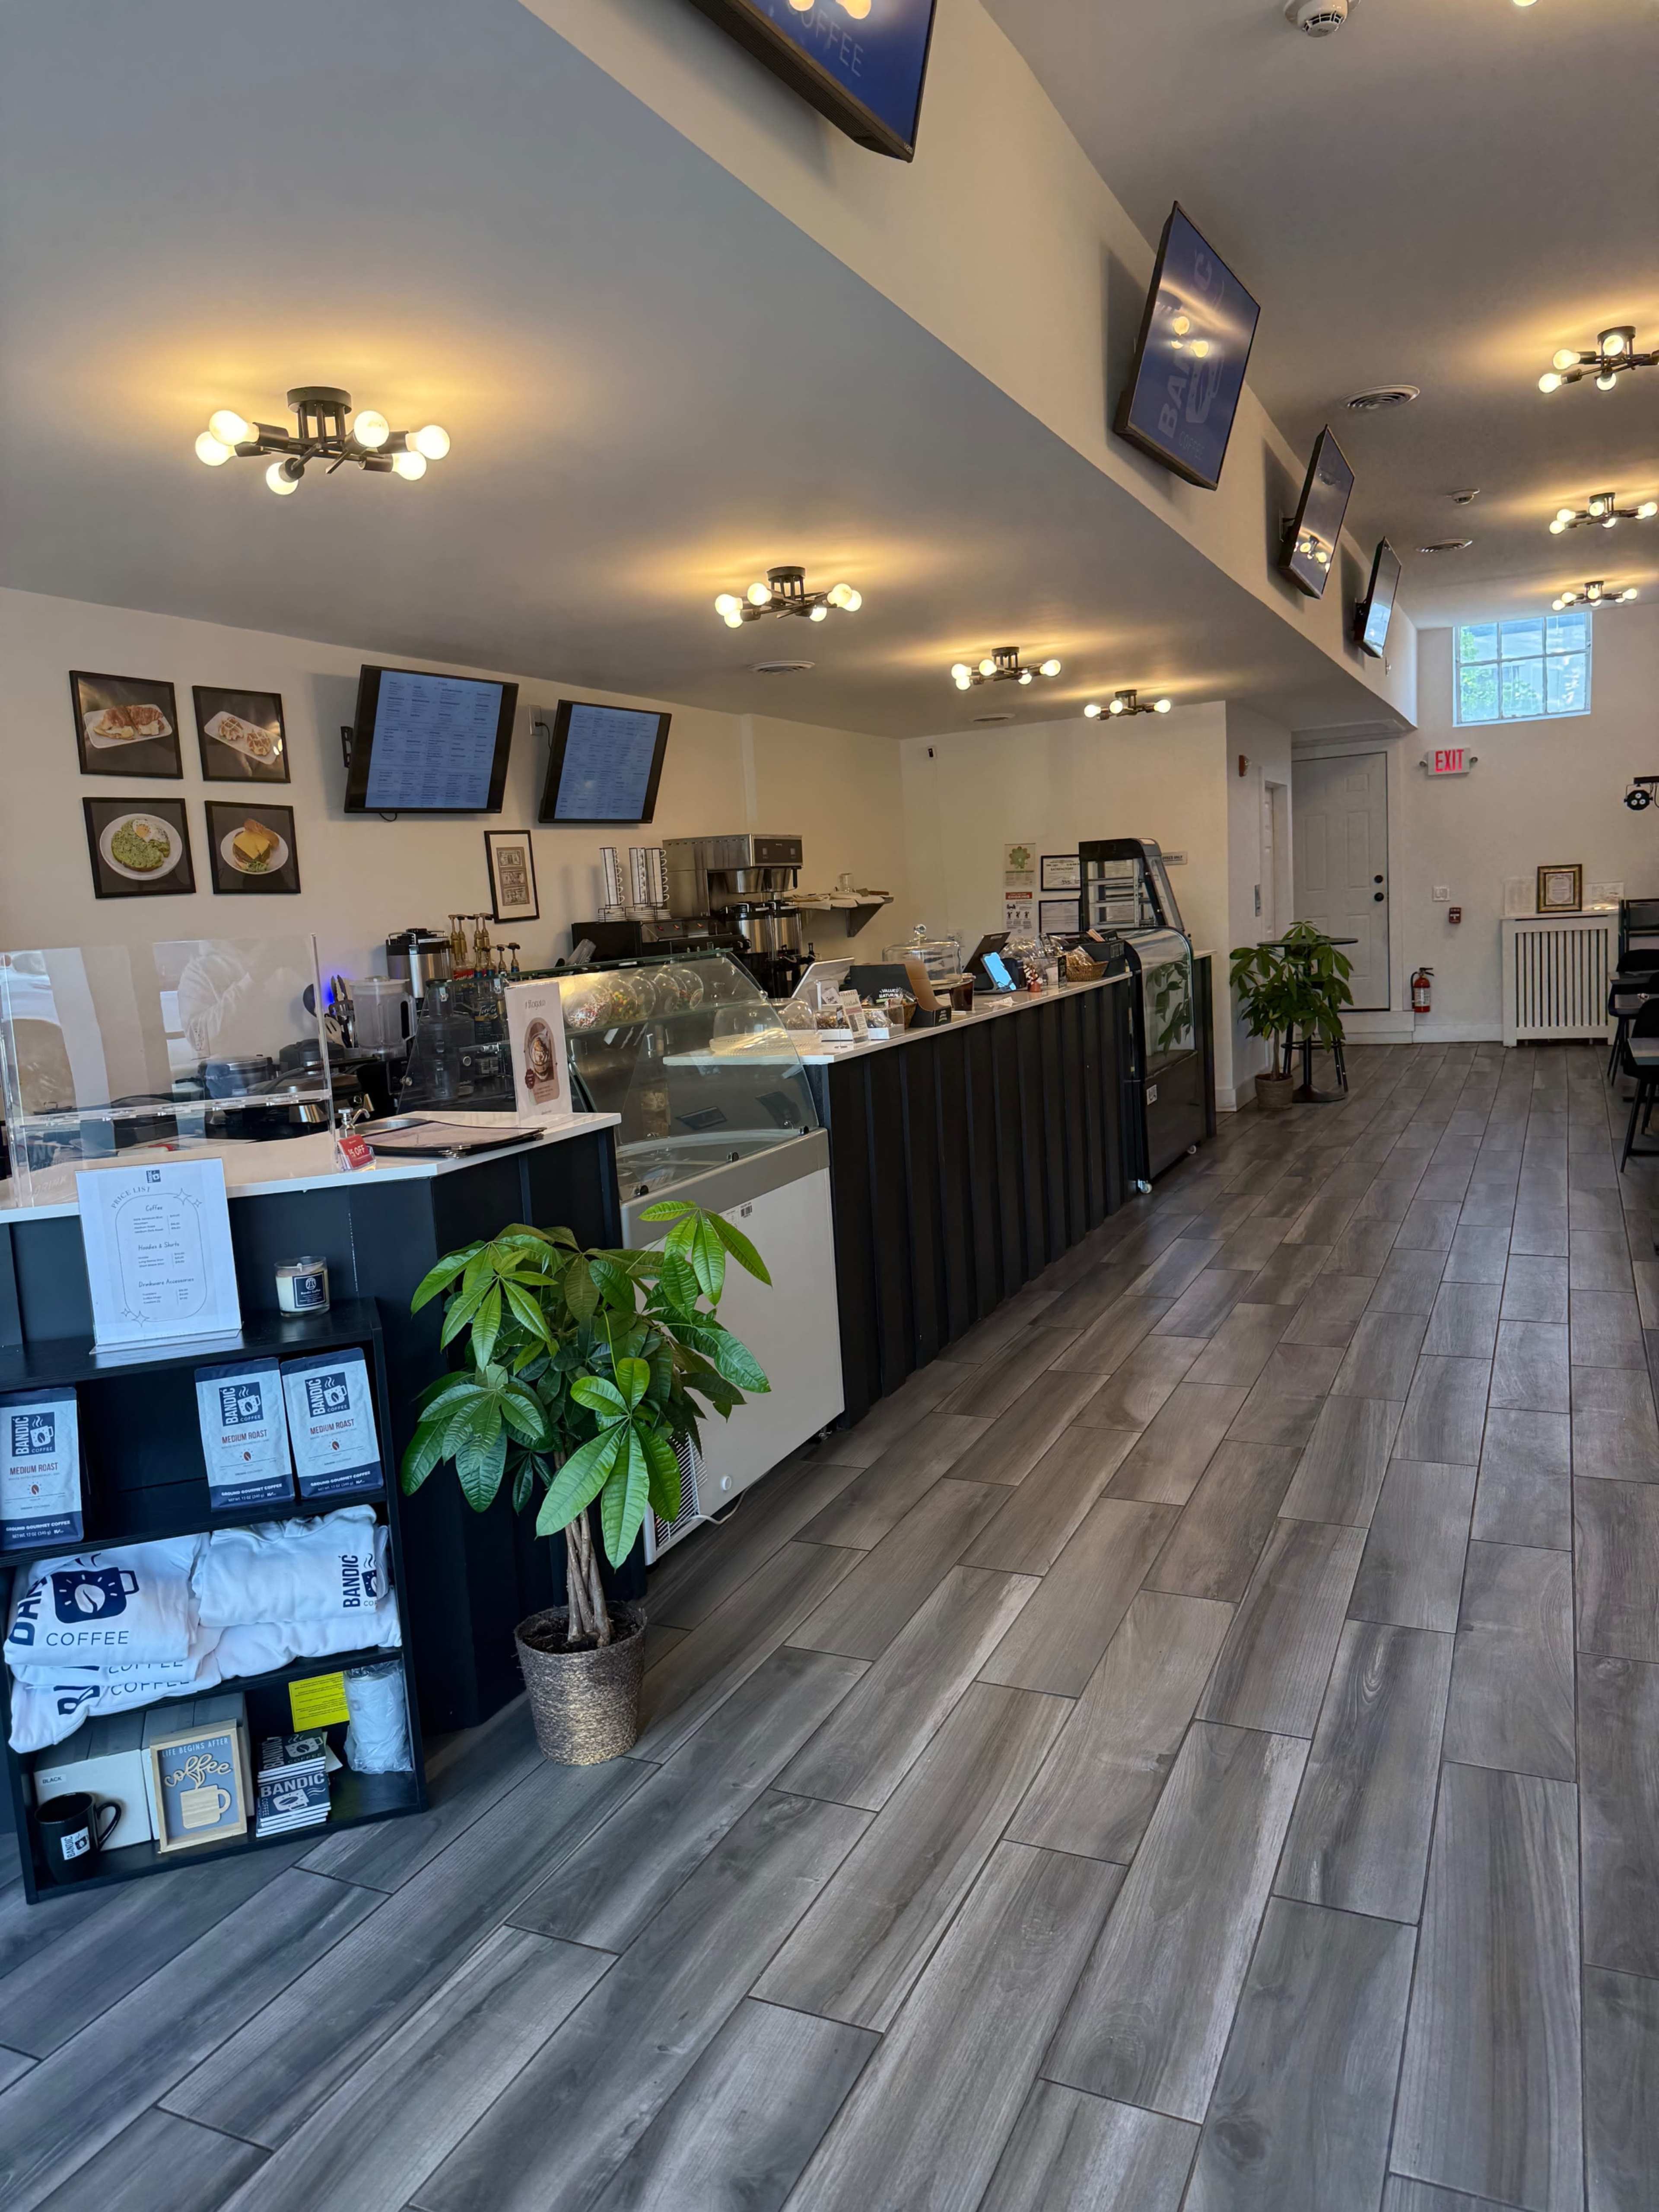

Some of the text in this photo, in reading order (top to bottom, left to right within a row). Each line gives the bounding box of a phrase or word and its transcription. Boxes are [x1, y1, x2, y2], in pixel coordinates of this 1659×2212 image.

[788, 0, 864, 77] OFFEE
[1435, 749, 1464, 772] EXIT
[354, 1144, 365, 1156] OFF
[111, 1190, 131, 1209] PRICE
[220, 1388, 238, 1425] BANDIĆ
[306, 1378, 325, 1416] BANDIĆ
[13, 1416, 29, 1455] BANDIĆ
[222, 1433, 247, 1444] MEDIUM
[248, 1429, 267, 1440] ROAST
[310, 1422, 335, 1435] MEDIUM
[336, 1419, 355, 1430] ROAST
[10, 1462, 58, 1475] MEDIUM ROAST
[338, 1555, 360, 1608] BANDIĆ
[46, 1631, 129, 1646] COFFEE
[162, 1738, 229, 1757] LIFE BEGINS AFTER
[288, 1752, 323, 1764] COFFEE
[164, 1753, 233, 1787] coffee
[261, 1798, 270, 1817] COFFEE
